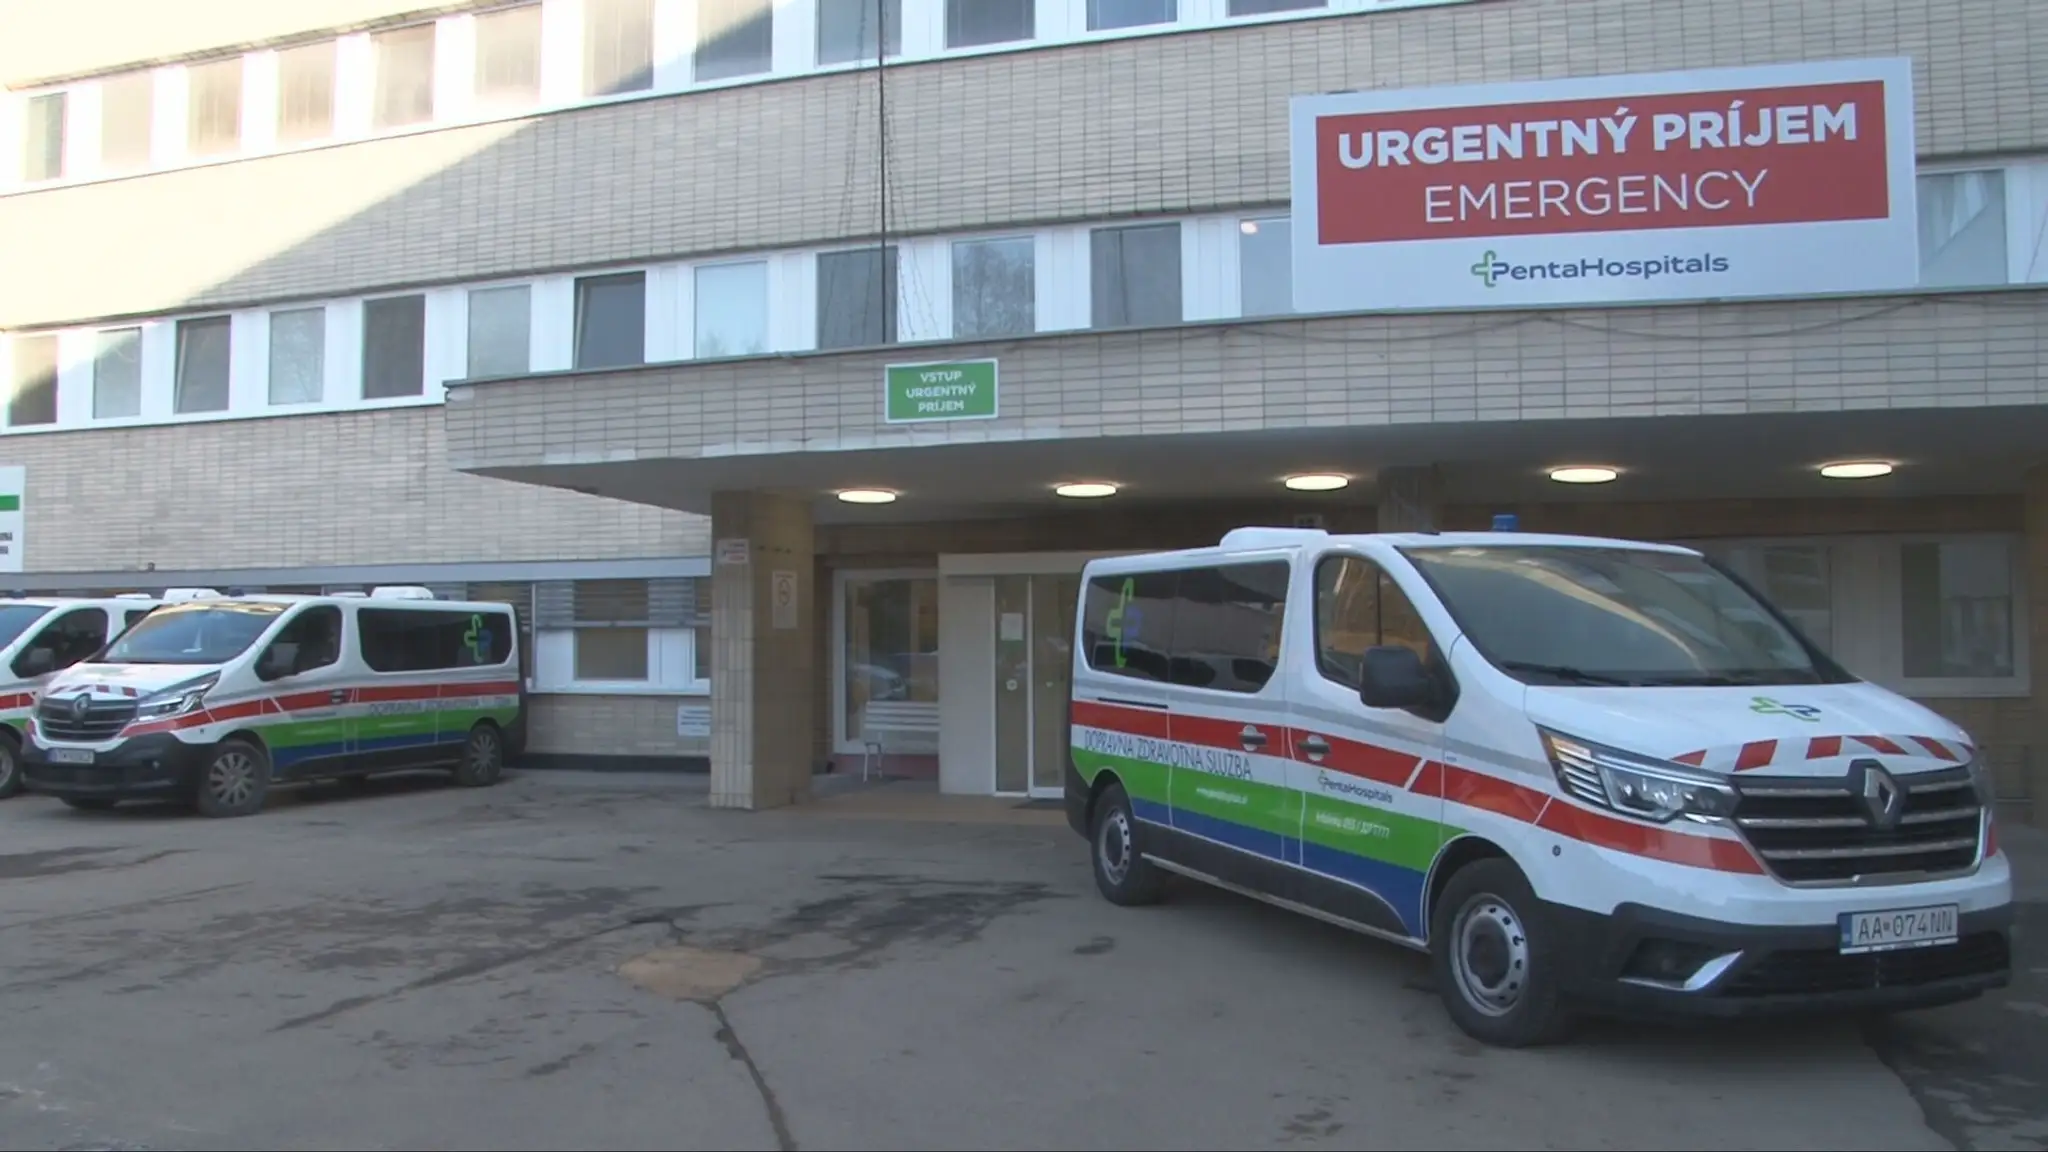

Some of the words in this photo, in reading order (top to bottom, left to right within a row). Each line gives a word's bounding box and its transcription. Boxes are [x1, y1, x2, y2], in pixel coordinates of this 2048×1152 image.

[1338, 106, 1638, 169] URGENTNÝ
[1653, 100, 1857, 151] PRÍJEM
[1425, 169, 1768, 223] EMERGENCY
[1491, 253, 1730, 287] PentaHospitals
[920, 370, 963, 383] VSTUP
[905, 382, 977, 399] URGENTNÝ
[918, 399, 965, 413] PRÍJEM
